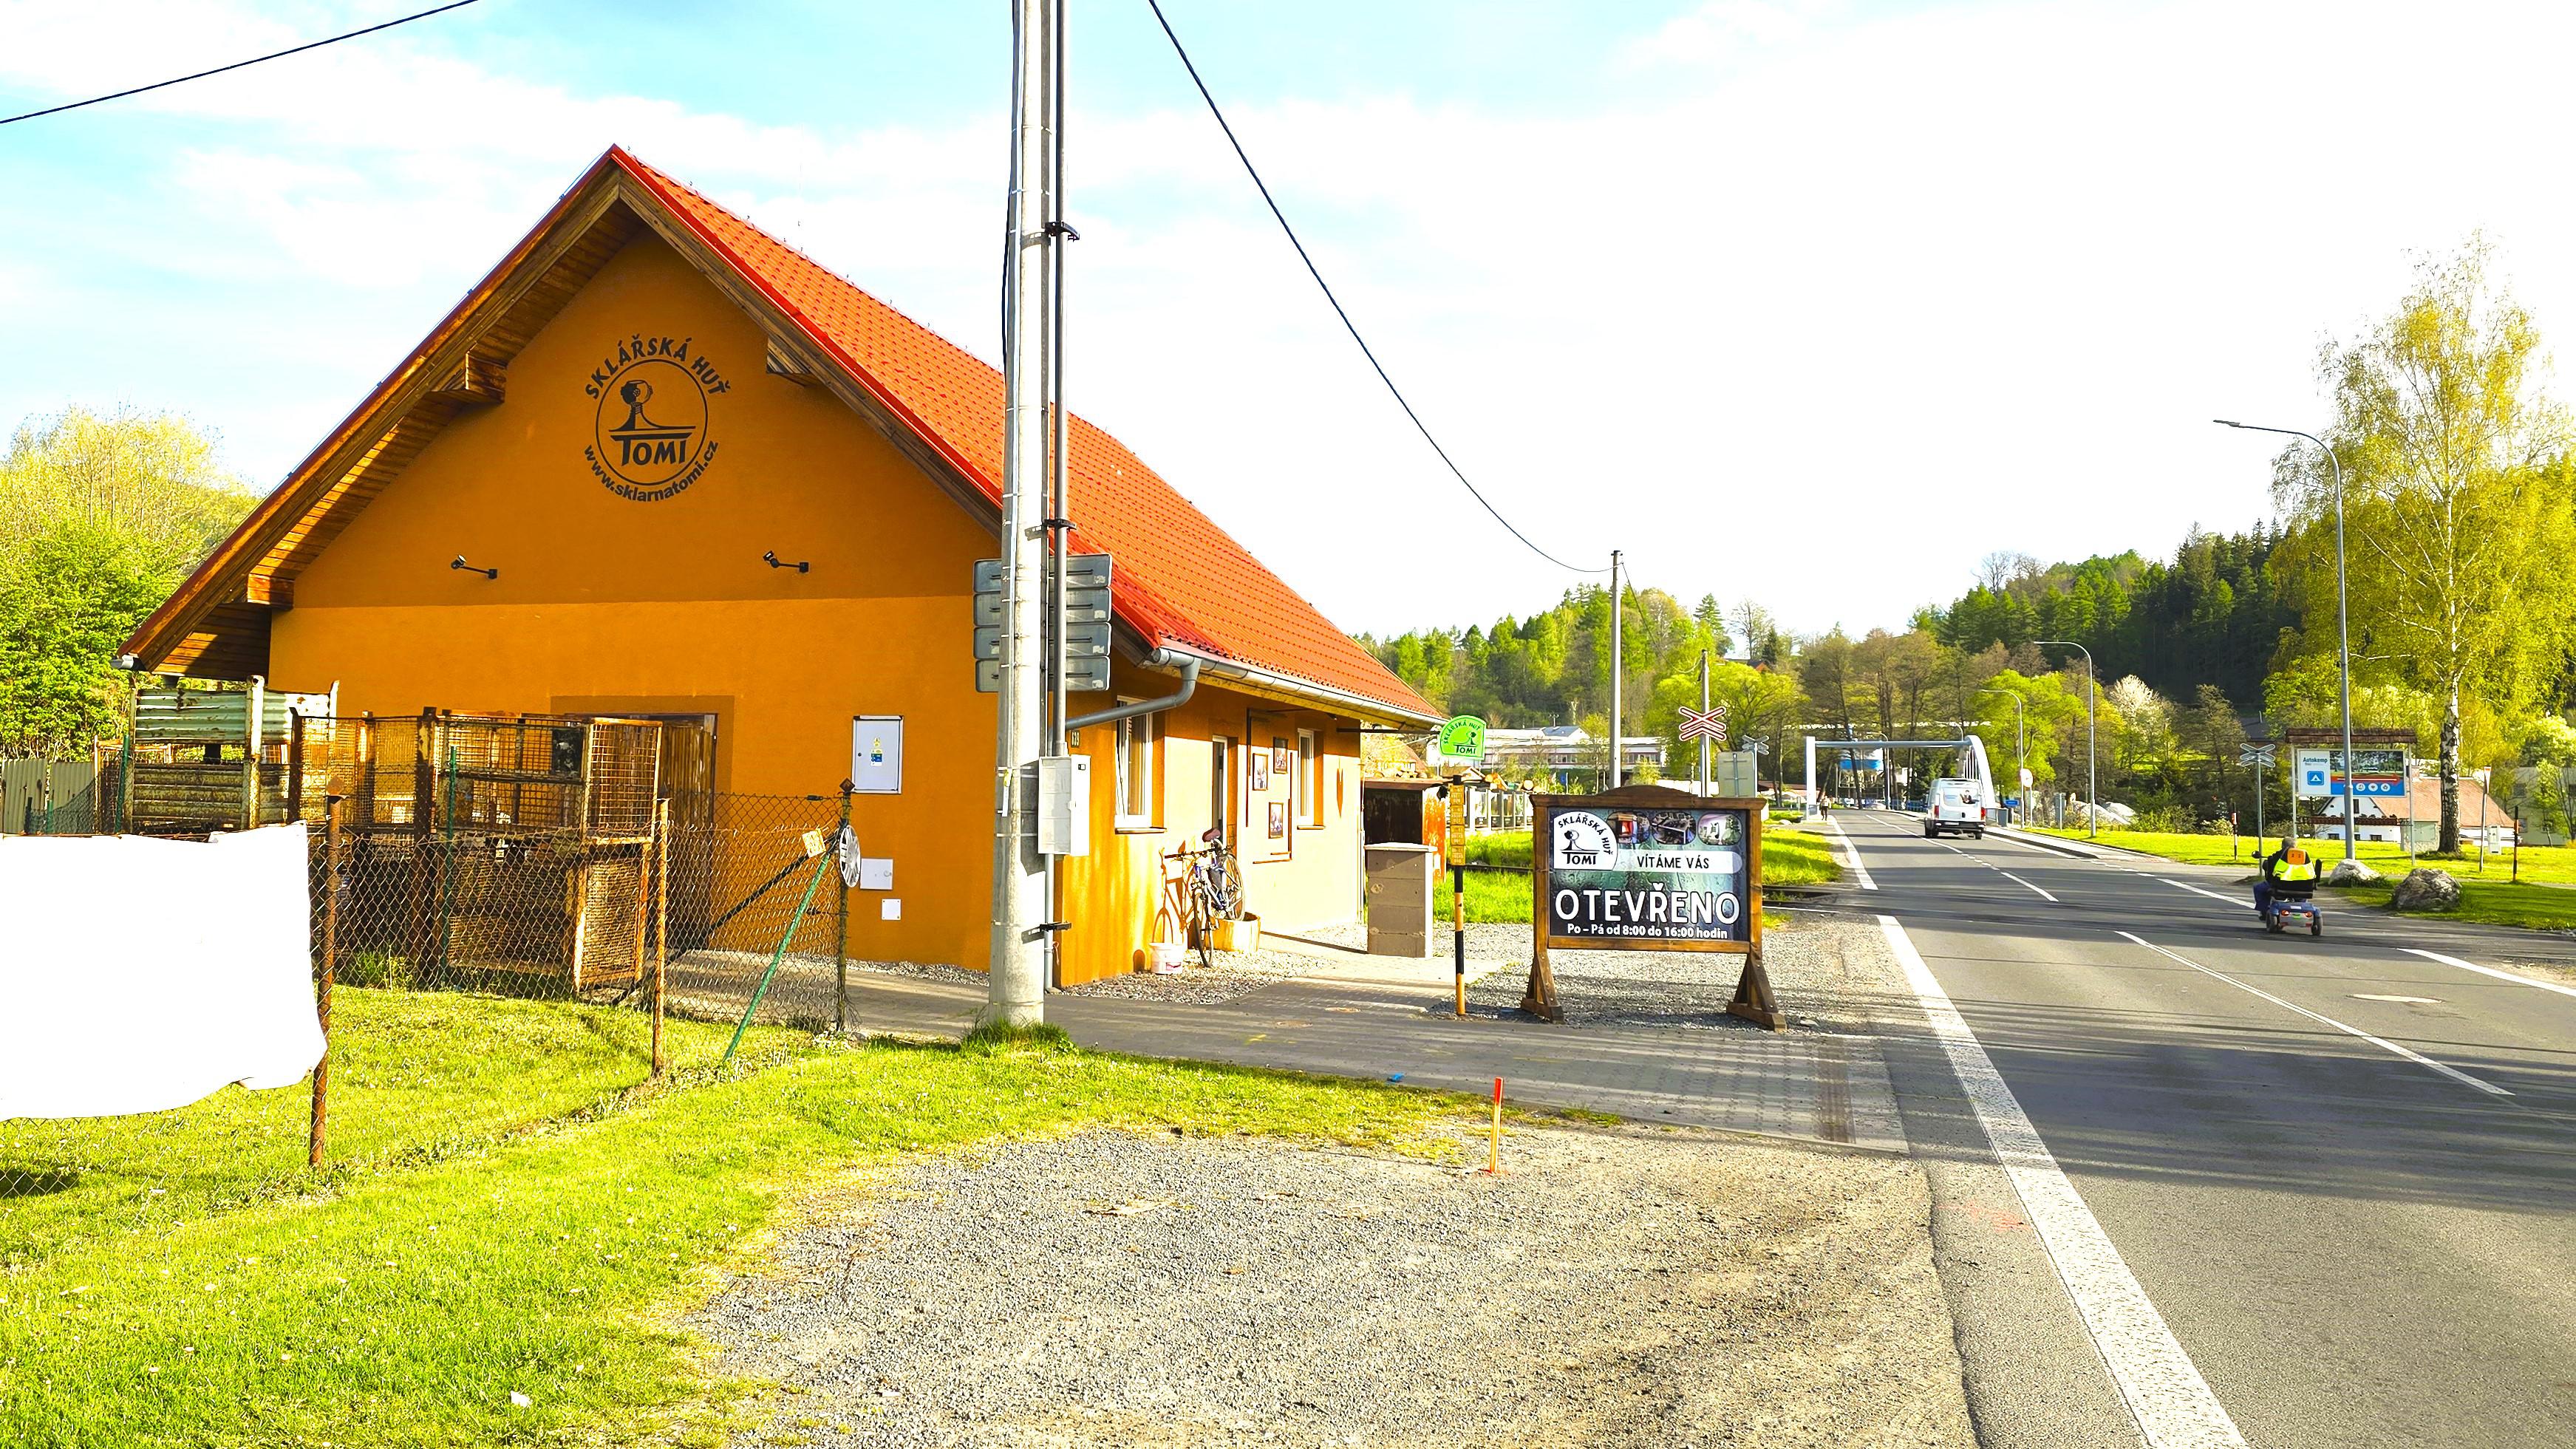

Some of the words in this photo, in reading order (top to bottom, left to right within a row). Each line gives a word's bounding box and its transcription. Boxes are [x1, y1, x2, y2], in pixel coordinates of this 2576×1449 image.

[585, 333, 692, 400] SKLÁŘSKÁ
[690, 355, 731, 395] HUŤ
[610, 432, 693, 467] TOMI
[584, 440, 719, 502] www.sklarnatomi.cz
[1454, 744, 1476, 754] TOMI
[1558, 814, 1606, 836] SKLÁŘSKÁ
[1601, 837, 1613, 856] HUŤ
[1561, 851, 1600, 865] TOMI
[1637, 853, 1681, 869] VÍTÁME
[1686, 854, 1709, 869] VÁS
[1555, 882, 1740, 924] OTEVŘENO
[1567, 924, 1581, 934] Po
[1591, 924, 1604, 935] Pá
[1606, 924, 1621, 935] od
[1622, 925, 1646, 936] 8:00
[1648, 926, 1662, 937] do
[1664, 927, 1694, 938] 16:00
[1696, 927, 1728, 939] hodin
